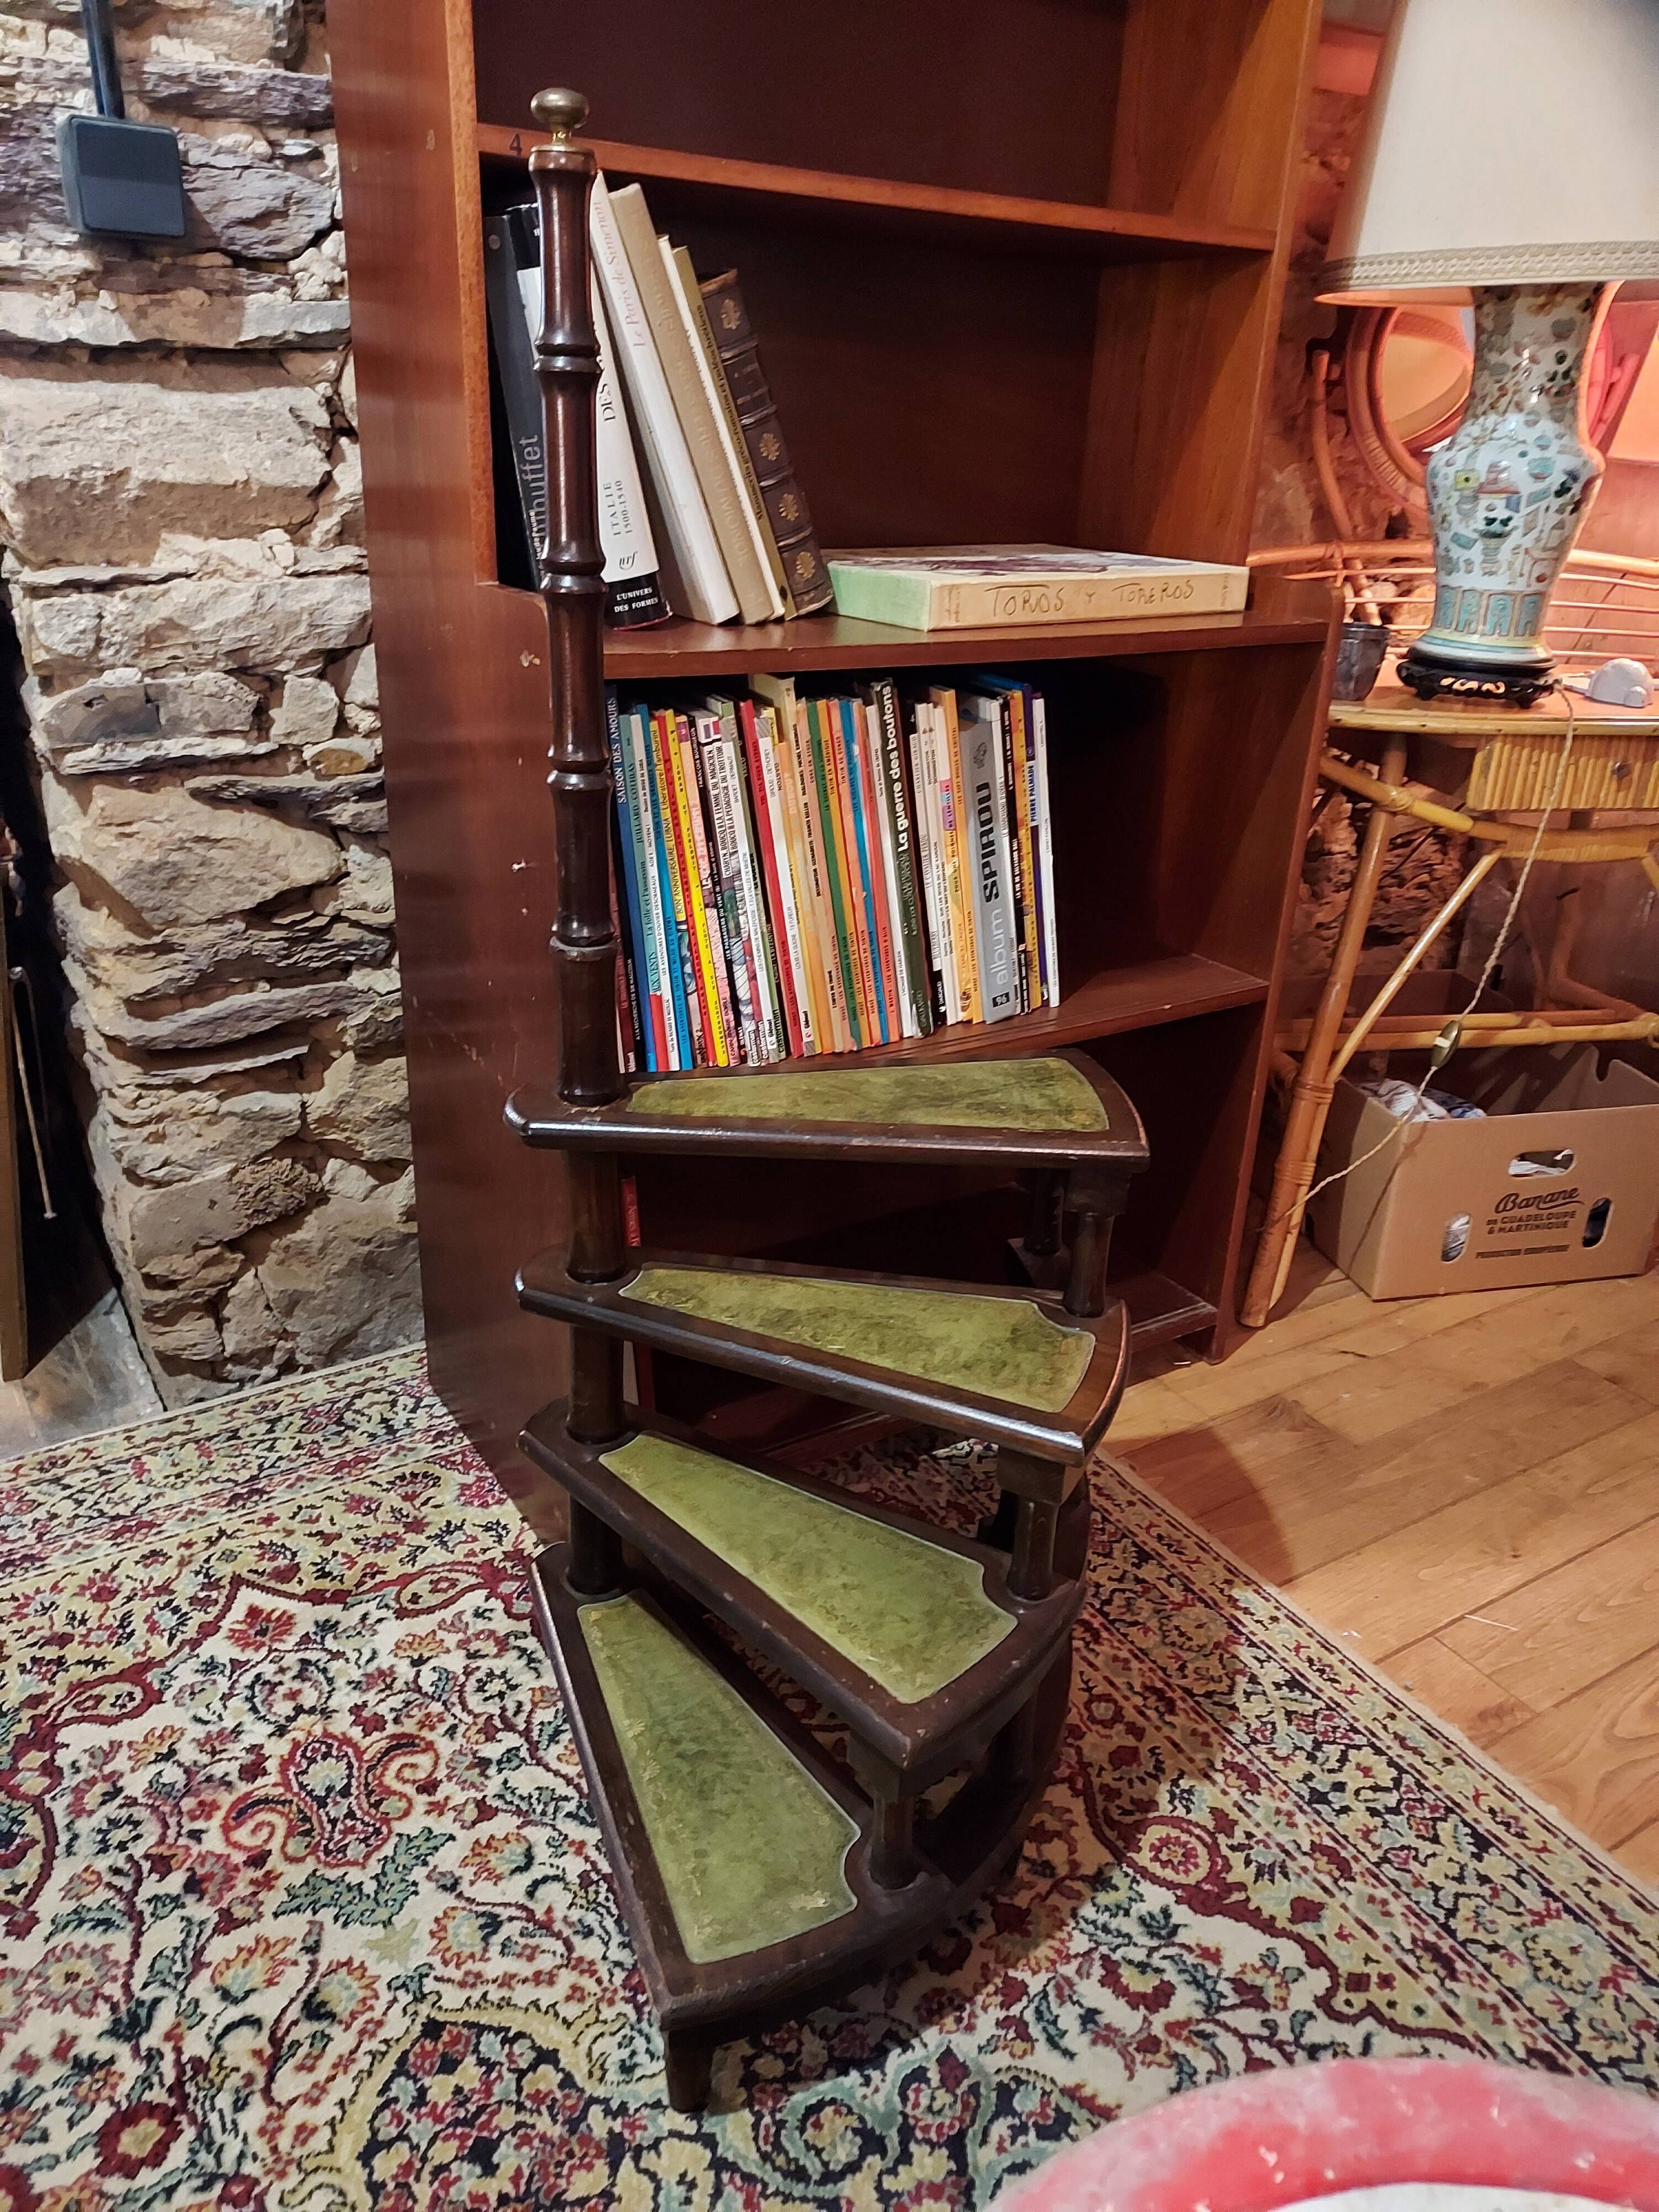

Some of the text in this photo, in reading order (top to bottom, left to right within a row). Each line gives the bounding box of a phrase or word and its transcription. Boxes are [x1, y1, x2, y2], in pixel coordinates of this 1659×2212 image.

[593, 202, 645, 347] Le Paris de Simenon
[599, 382, 615, 421] DES
[603, 483, 619, 536] ITALIE
[615, 480, 633, 534] 1500-1540
[614, 597, 658, 613] DES FORMES
[617, 587, 652, 601] L'UNIVERS
[984, 585, 1065, 617] TOROS
[1084, 591, 1097, 606] Y
[1112, 579, 1195, 604] TOREROS
[880, 686, 896, 749] boutons
[606, 697, 627, 804] SAISON DES AMOURS
[690, 728, 699, 759] BOURGEON
[714, 745, 725, 774] TROTTOIR
[727, 756, 735, 779] DERMAUT
[887, 750, 900, 780] des
[719, 775, 727, 783] DU
[774, 763, 782, 791] GASTON
[628, 763, 643, 843] JUILLARD COTHIAS
[705, 749, 727, 850] BOUCQ LA FEMME DU MAGICIEN
[784, 771, 796, 814] DUBOUT
[890, 781, 908, 831] guerre
[663, 817, 674, 842] LUBNA
[726, 817, 733, 825] LA
[727, 830, 737, 850] BOUCQ
[896, 832, 908, 852] La
[975, 781, 999, 903] SPIROU
[922, 853, 931, 880] CAVALIER
[638, 861, 653, 936] La folle l'assassin
[651, 875, 659, 910] DESORMEAUX
[702, 879, 711, 889] LE
[674, 899, 684, 914] BON
[720, 917, 729, 949] PASSAGERS
[750, 909, 758, 936] MALEFOSSE
[930, 930, 940, 960] BLUEBERRY
[987, 908, 1007, 985] album
[648, 951, 658, 975] VENTS
[834, 962, 842, 989] AVENTURES
[852, 957, 860, 984] AVENTURES
[784, 967, 793, 995] AVENTURES
[996, 994, 1007, 1005] 96
[677, 1003, 685, 1032] AVENTURES
[773, 1009, 784, 1053] casterman
[801, 1010, 810, 1029] Glénat
[748, 1030, 759, 1064] casterman
[757, 1021, 768, 1059] casterman
[627, 1051, 636, 1072] Glénat
[1495, 1187, 1585, 1214] Banane
[1498, 1220, 1569, 1234] MARTINIQUE
[1500, 1211, 1576, 1224] GUADELOUPE
